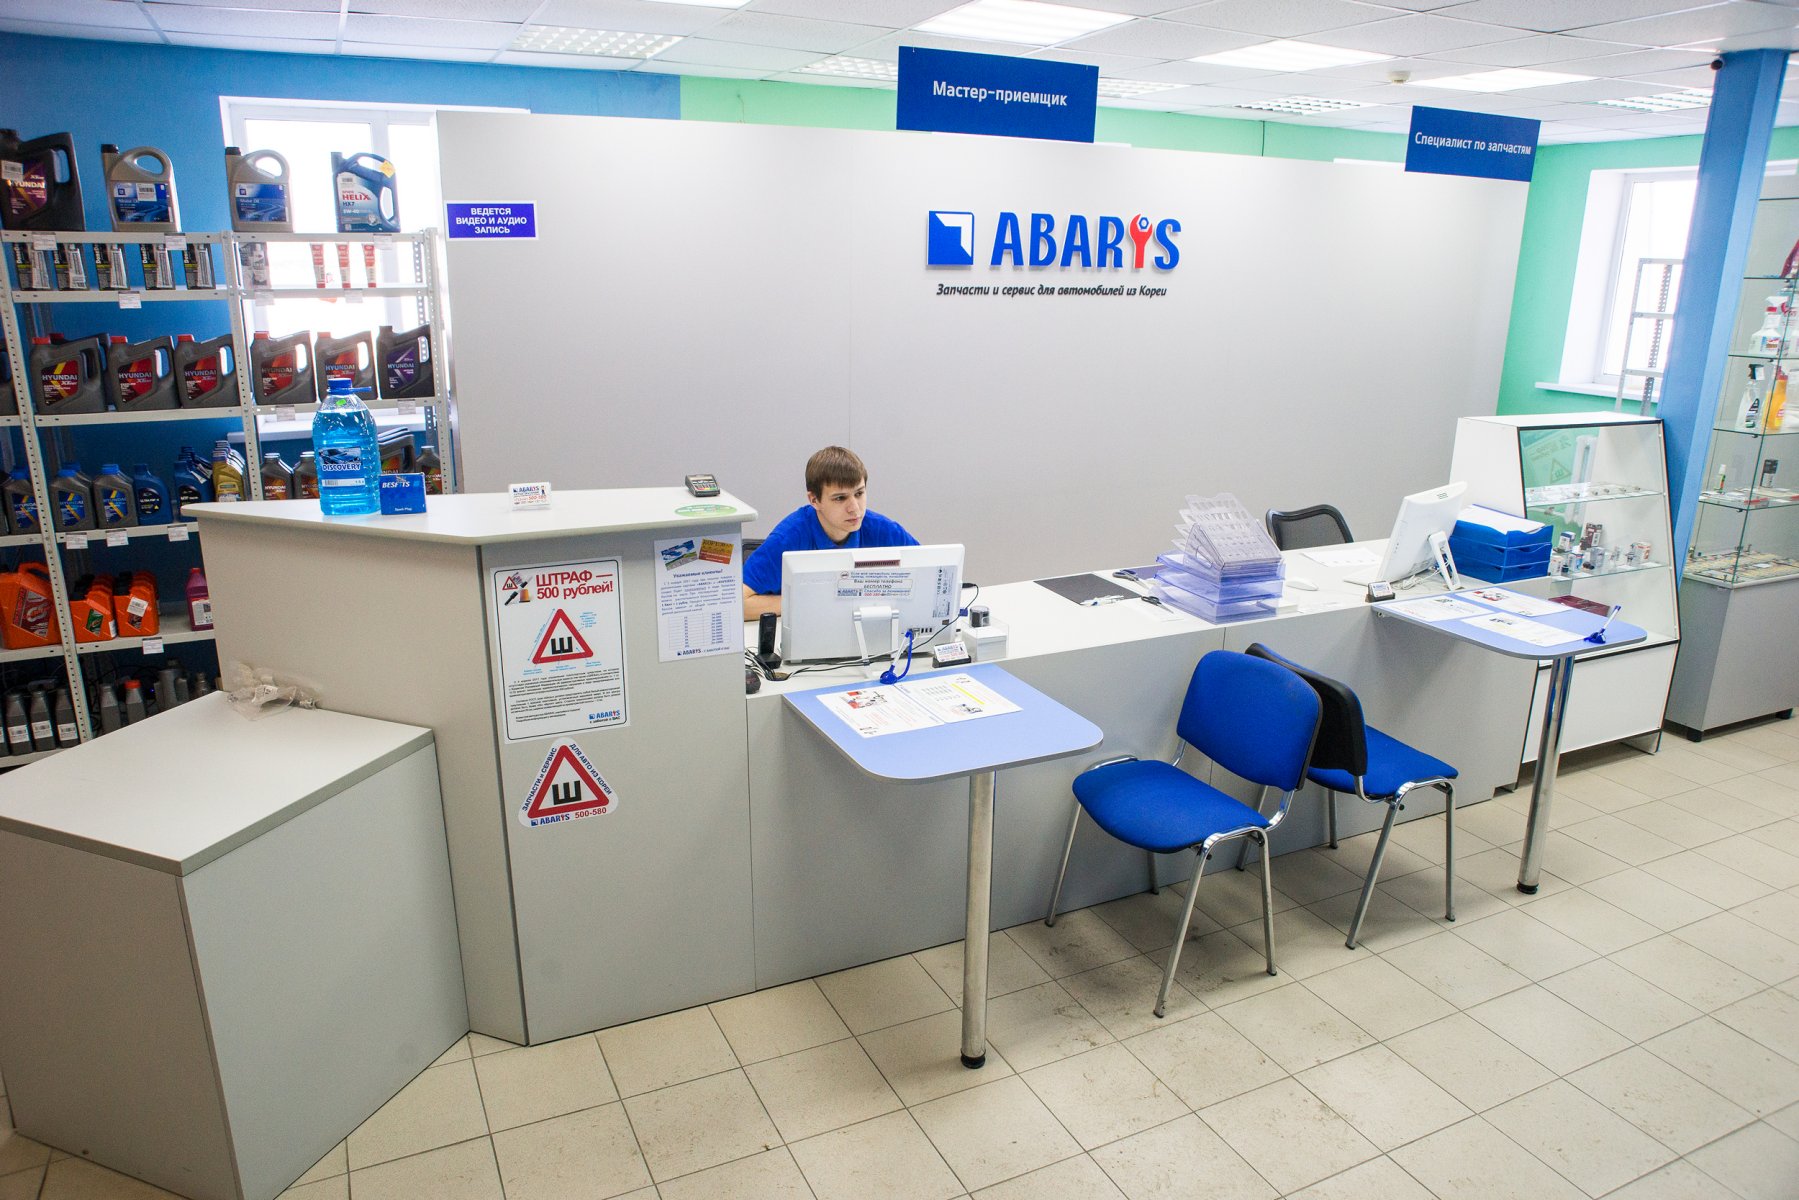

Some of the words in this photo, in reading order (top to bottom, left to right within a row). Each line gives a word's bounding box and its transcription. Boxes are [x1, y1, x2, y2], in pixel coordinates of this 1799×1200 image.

[932, 80, 1068, 107] Мастер-приемщик
[1415, 132, 1472, 149] Специалист
[1474, 140, 1486, 151] по
[1488, 142, 1532, 155] запчастям
[456, 217, 486, 226] ВИДЕО
[496, 216, 528, 226] АУДИО
[470, 208, 512, 216] ВЕДЕТСЯ
[990, 211, 1182, 270] ABARYS
[936, 283, 990, 296] Запчасти
[992, 286, 1000, 296] и
[1002, 286, 1036, 298] сервис
[1037, 284, 1056, 297] для
[1057, 284, 1124, 297] автомобилей
[1126, 287, 1137, 296] из
[1138, 286, 1167, 298] Кореи
[322, 463, 362, 472] DISCOVERY
[536, 570, 592, 587] ШТРАФ
[536, 586, 559, 600] 500
[563, 580, 613, 600] рублей!
[550, 636, 573, 654] Ш
[596, 710, 620, 718] ABARYS
[569, 744, 582, 756] ДЛЯ
[579, 754, 593, 770] АВТО
[590, 769, 599, 778] ИЗ
[596, 776, 612, 795] КОРЕИ
[522, 778, 542, 812] ЗАПЧАСТИ
[541, 747, 557, 773] СЕРВИС
[552, 780, 582, 806] Ш
[540, 814, 570, 825] ABARYS
[574, 807, 607, 819] 500-580
